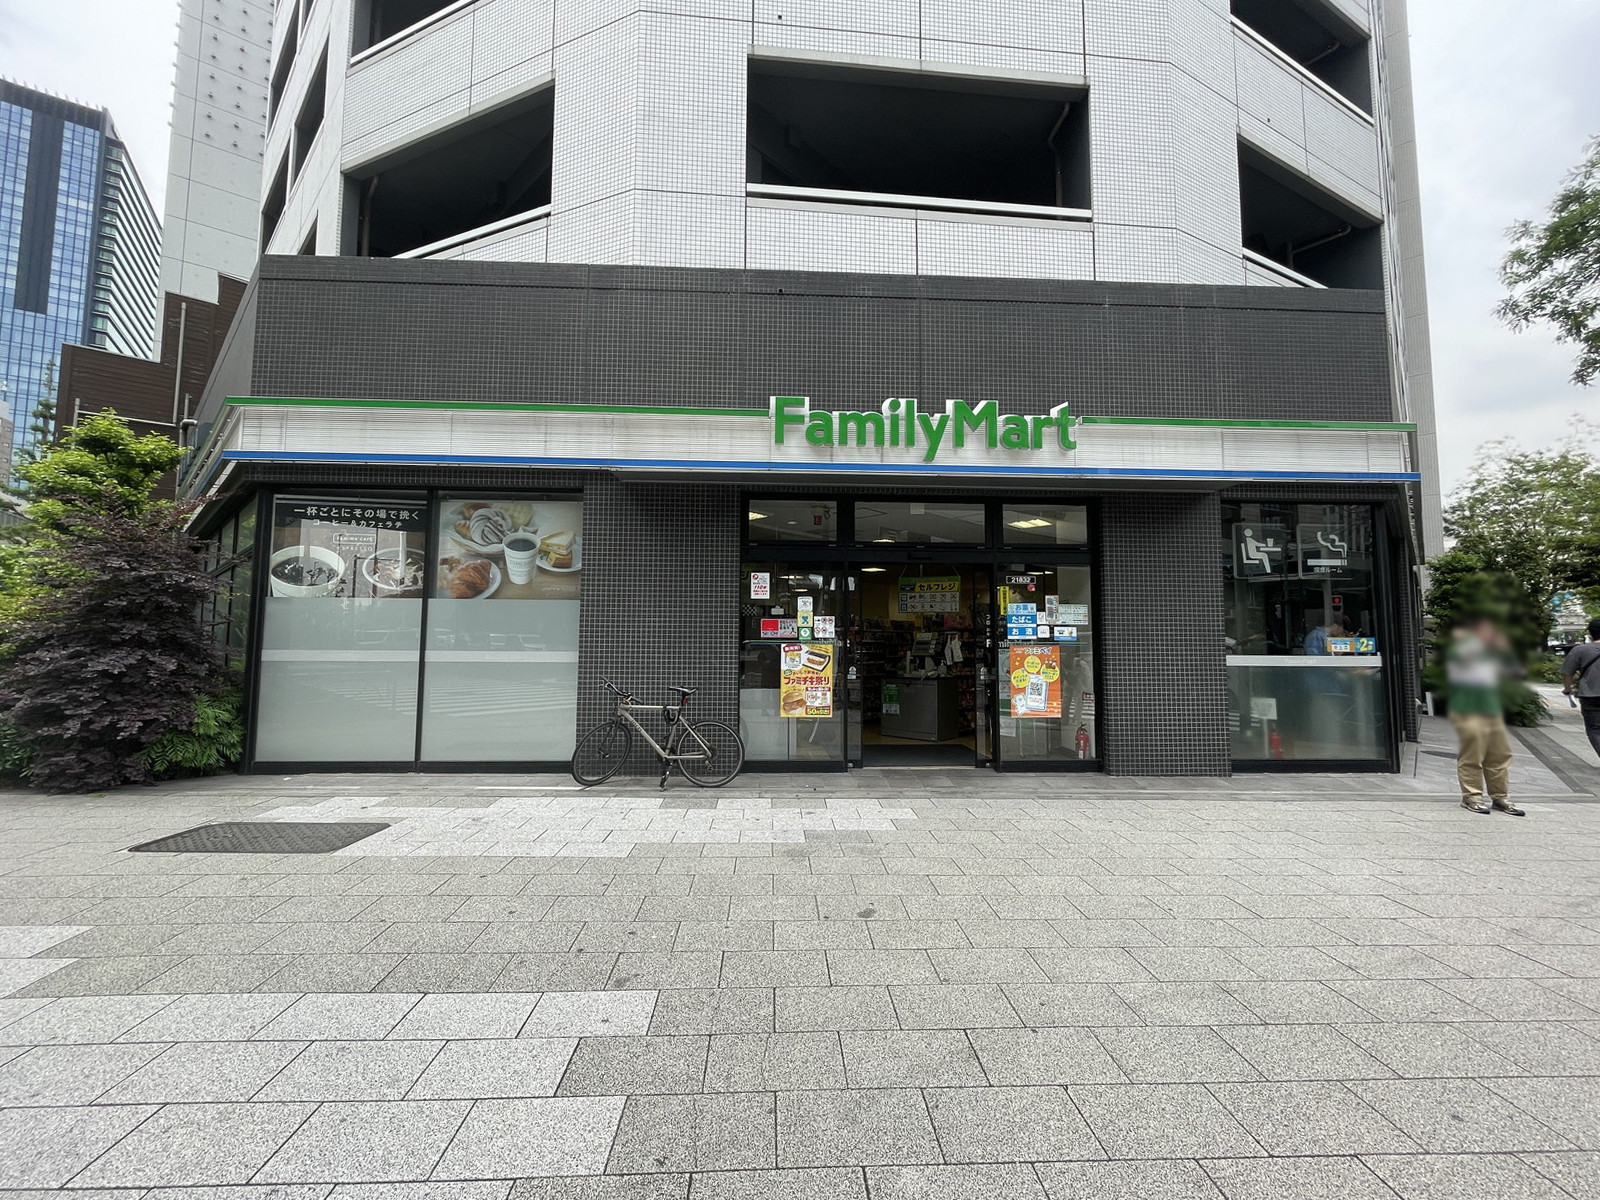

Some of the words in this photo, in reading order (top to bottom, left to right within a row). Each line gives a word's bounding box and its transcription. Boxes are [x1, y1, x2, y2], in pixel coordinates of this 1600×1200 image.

[772, 396, 1078, 462] FamilyMart
[294, 506, 420, 520] 一杯ごとにその場で挽く
[312, 518, 403, 529] コーヒー&カフェラテ
[918, 583, 956, 591] セルフレジ
[1011, 616, 1032, 624] たばこ
[784, 676, 830, 686] ファミチキ祭り
